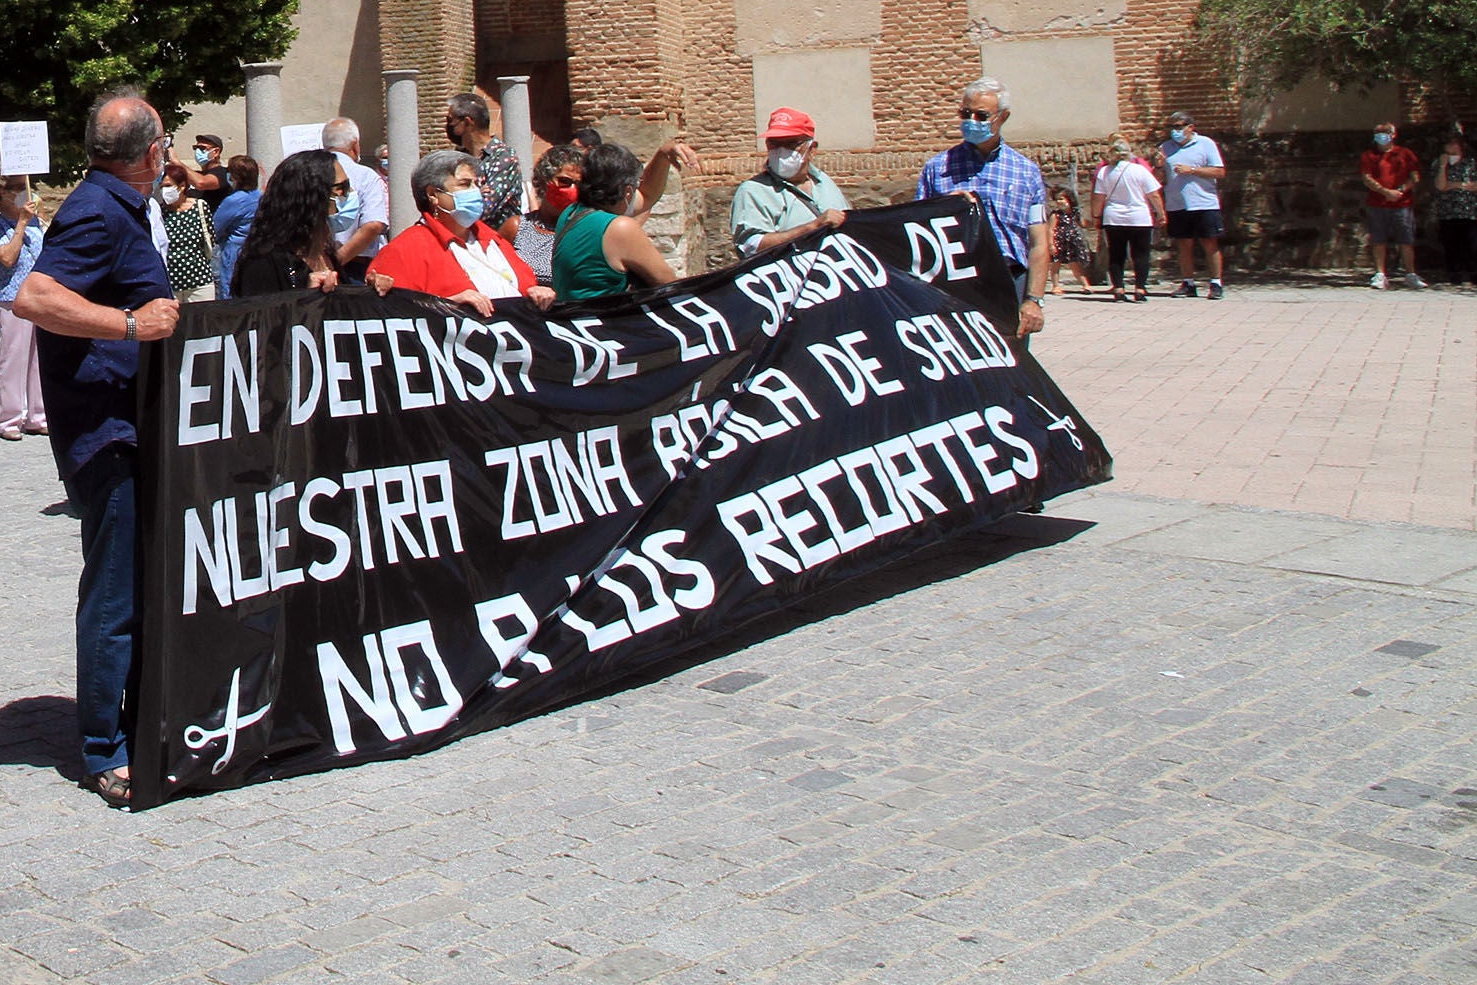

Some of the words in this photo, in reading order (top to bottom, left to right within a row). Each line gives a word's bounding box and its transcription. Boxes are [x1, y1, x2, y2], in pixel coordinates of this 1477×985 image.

[177, 328, 261, 446] EN
[290, 317, 537, 426] DEFENSA
[544, 318, 638, 388] DE
[642, 295, 737, 363] LA
[903, 216, 978, 283] DE
[182, 459, 464, 616] NUESTRA
[484, 425, 644, 541] ZONA
[806, 329, 905, 408] DE
[894, 310, 1019, 383] SALUD
[316, 619, 465, 755] NO
[474, 592, 554, 690] A
[560, 529, 717, 653] LOS
[716, 405, 1040, 586] RECORTES
